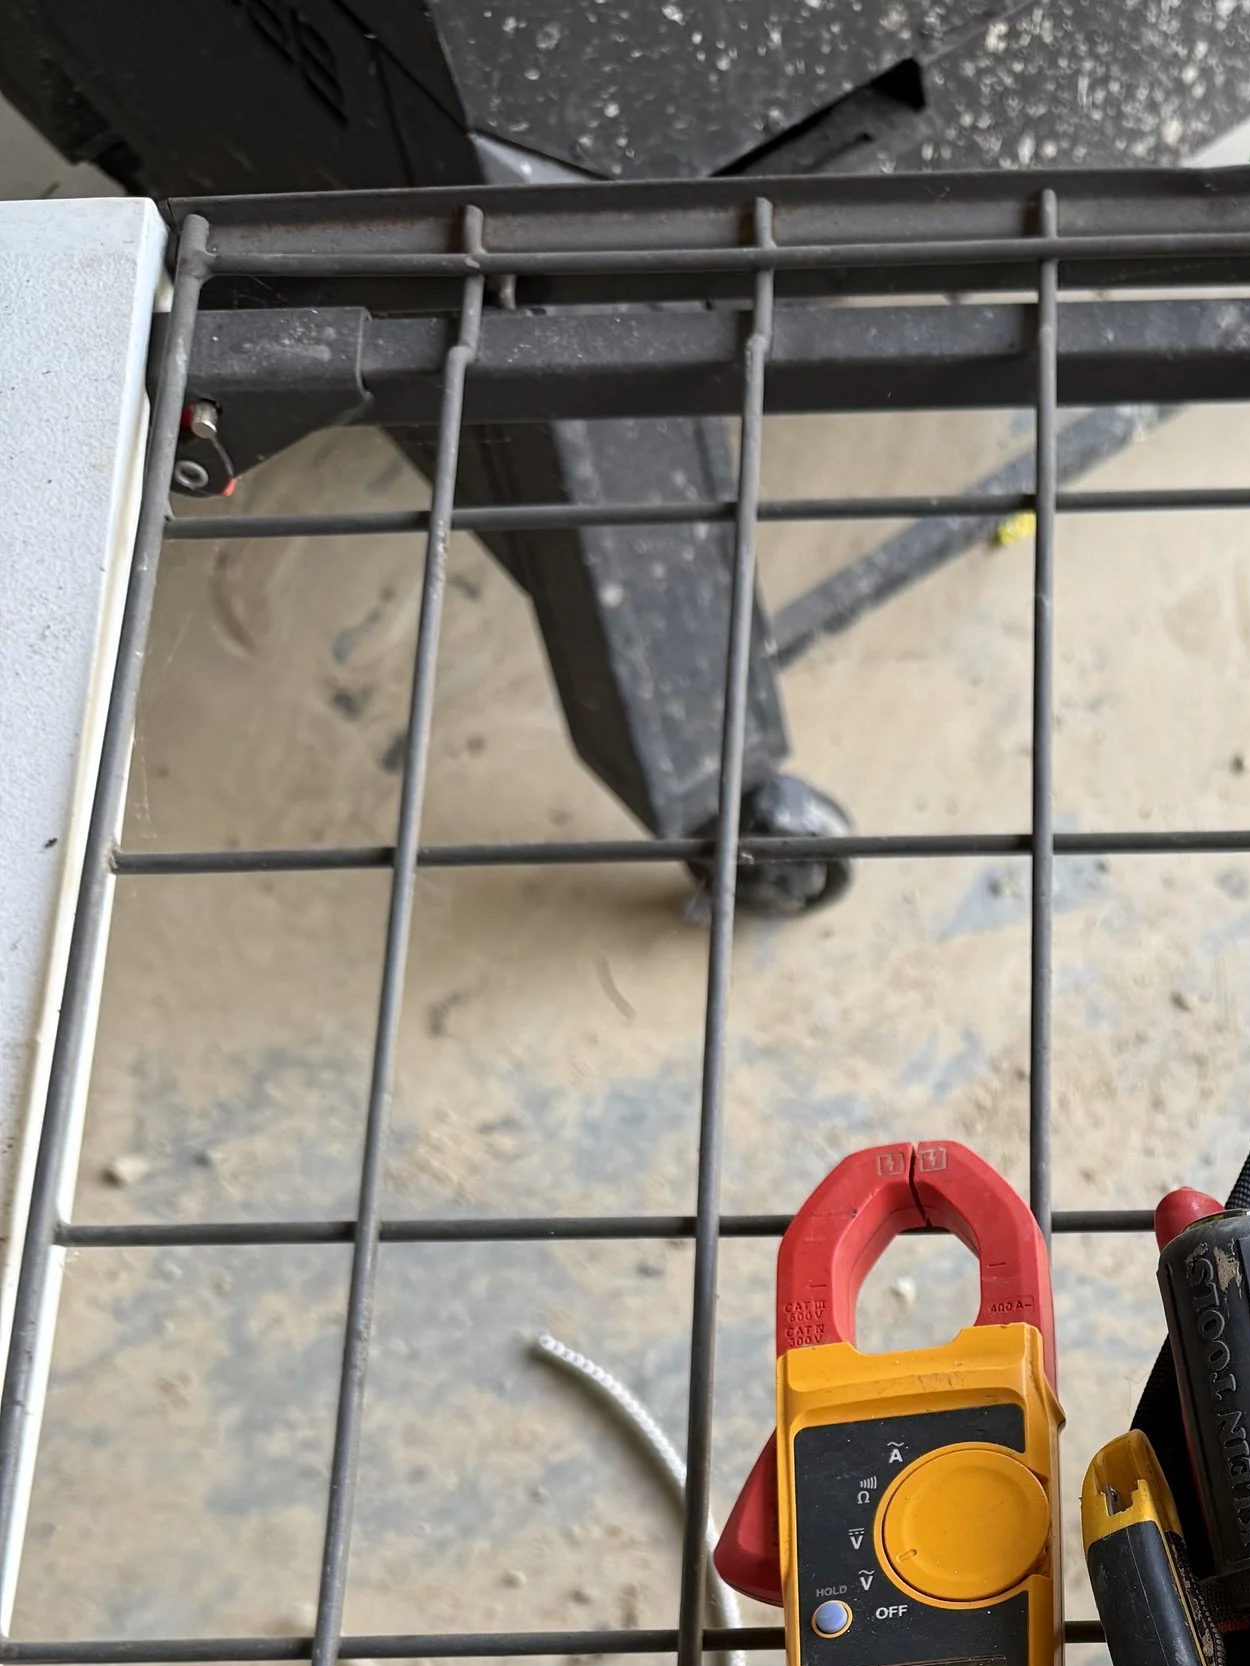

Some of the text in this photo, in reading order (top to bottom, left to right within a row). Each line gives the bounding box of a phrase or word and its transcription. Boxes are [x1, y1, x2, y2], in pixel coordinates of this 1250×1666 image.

[785, 1301, 811, 1313] CAT
[786, 1325, 812, 1337] CAT
[816, 1585, 847, 1597] HOLD
[876, 1605, 908, 1619] OFF
